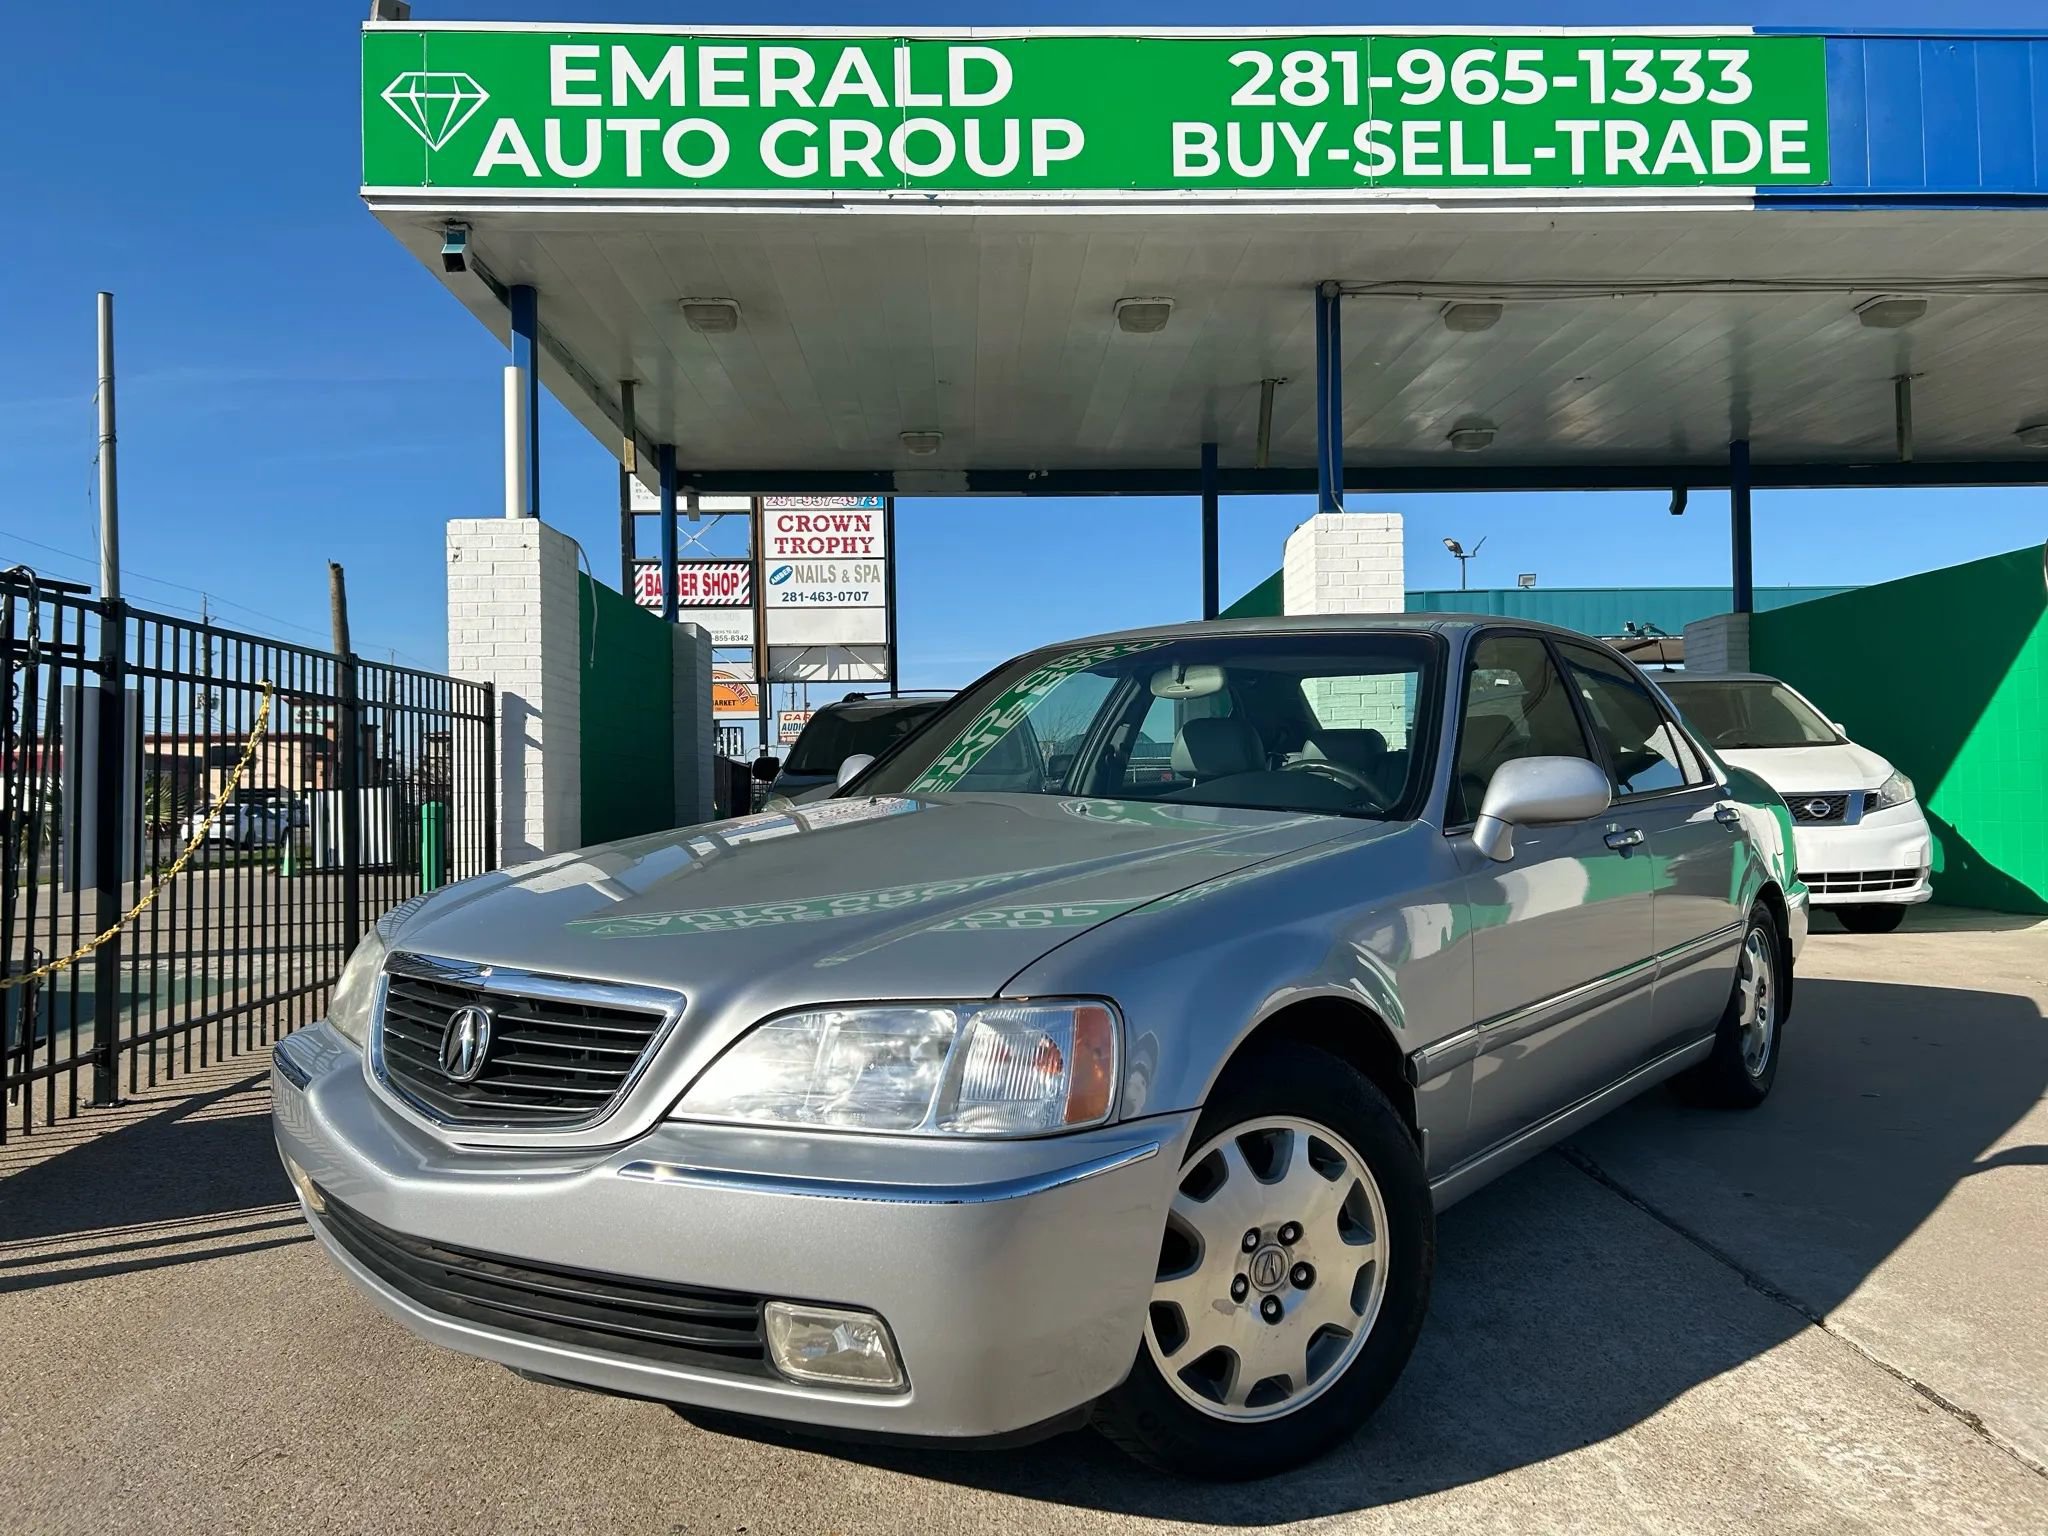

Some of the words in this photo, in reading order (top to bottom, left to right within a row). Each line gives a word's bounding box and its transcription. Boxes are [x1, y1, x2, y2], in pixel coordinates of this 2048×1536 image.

[550, 44, 1015, 108] EMERALD
[1227, 48, 1754, 107] 281-965-1333
[472, 117, 730, 179] AUTO
[758, 117, 1086, 179] GROUP
[1171, 118, 1812, 178] BUY-SELL-TRADE
[777, 514, 872, 533] CROWN
[774, 536, 875, 555] TROPHY
[645, 573, 698, 597] BAER
[702, 572, 740, 597] SHOP
[770, 565, 793, 585] AMBER
[794, 564, 837, 584] NAILS
[841, 568, 850, 584] &
[854, 564, 881, 584] SPA
[781, 591, 870, 602] 281-463-0707
